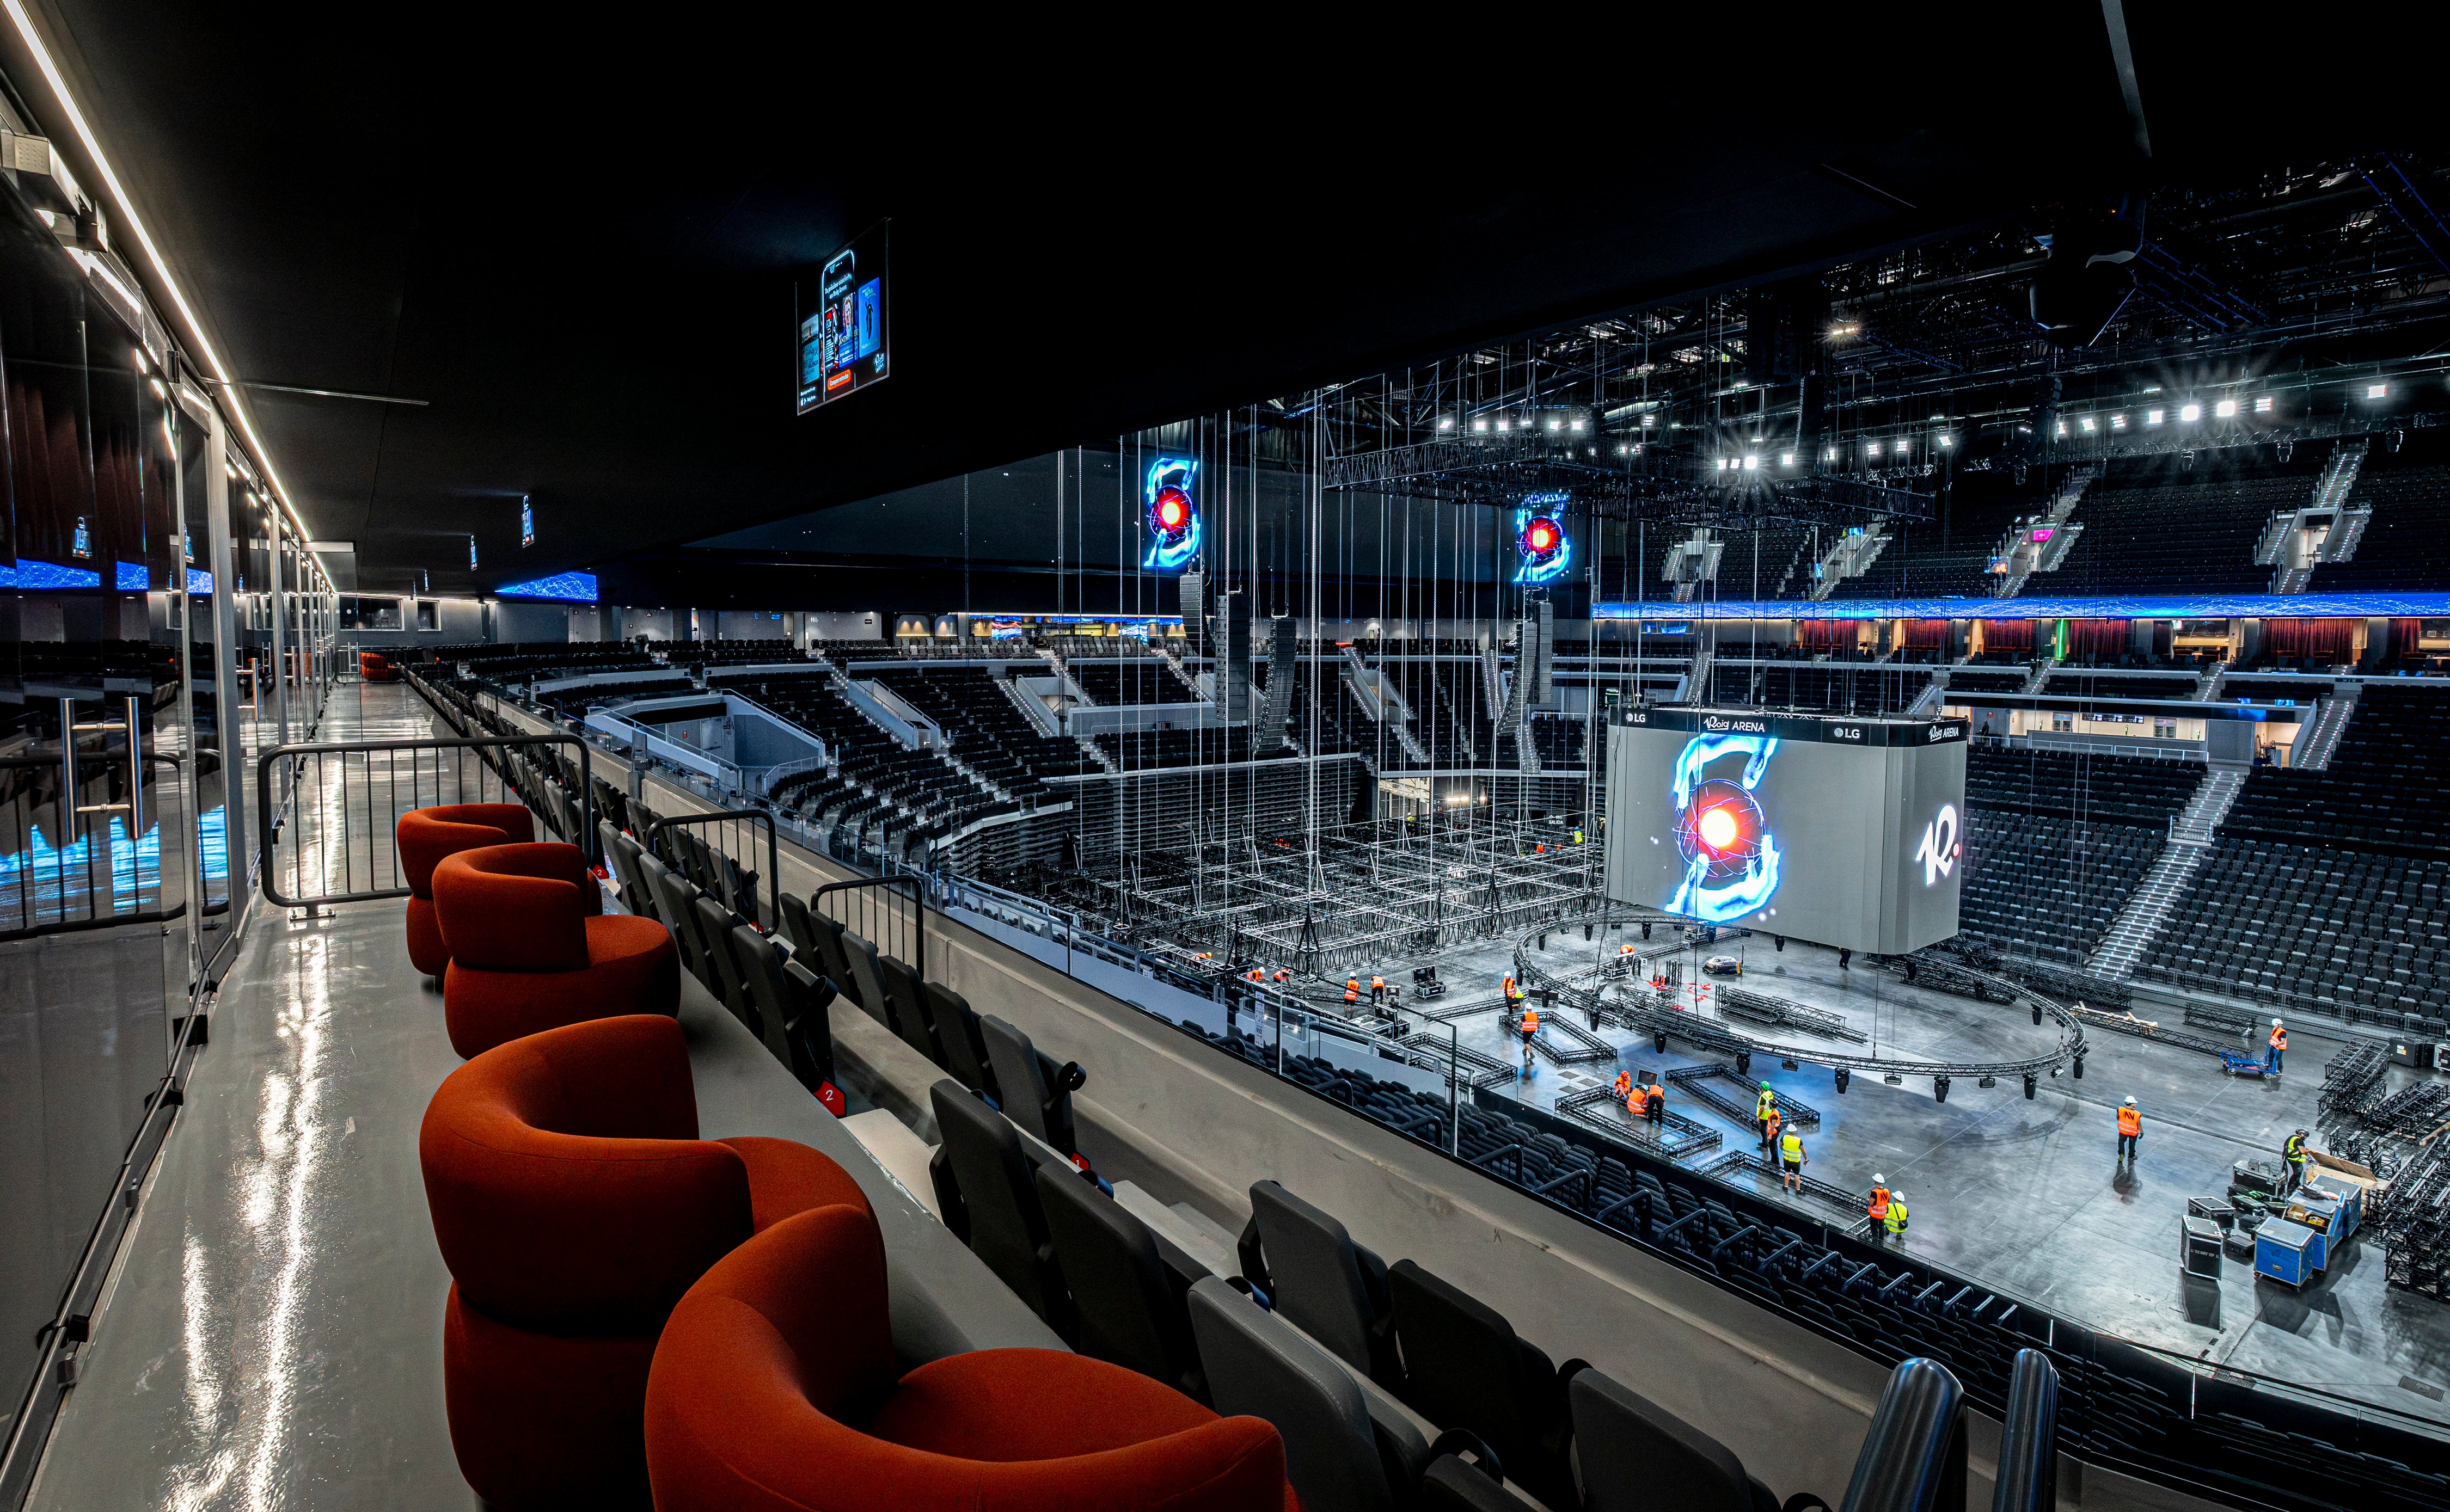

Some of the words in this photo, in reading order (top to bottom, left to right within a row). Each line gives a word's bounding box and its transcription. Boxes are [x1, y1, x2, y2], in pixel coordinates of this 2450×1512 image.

[1634, 713, 1645, 723] LG
[1703, 716, 1730, 731] Roig
[1731, 721, 1765, 733] ARENA
[1845, 728, 1860, 739] LG
[1928, 725, 1943, 742] Roig
[1942, 727, 1959, 738] ARENA
[825, 1089, 834, 1101] 2
